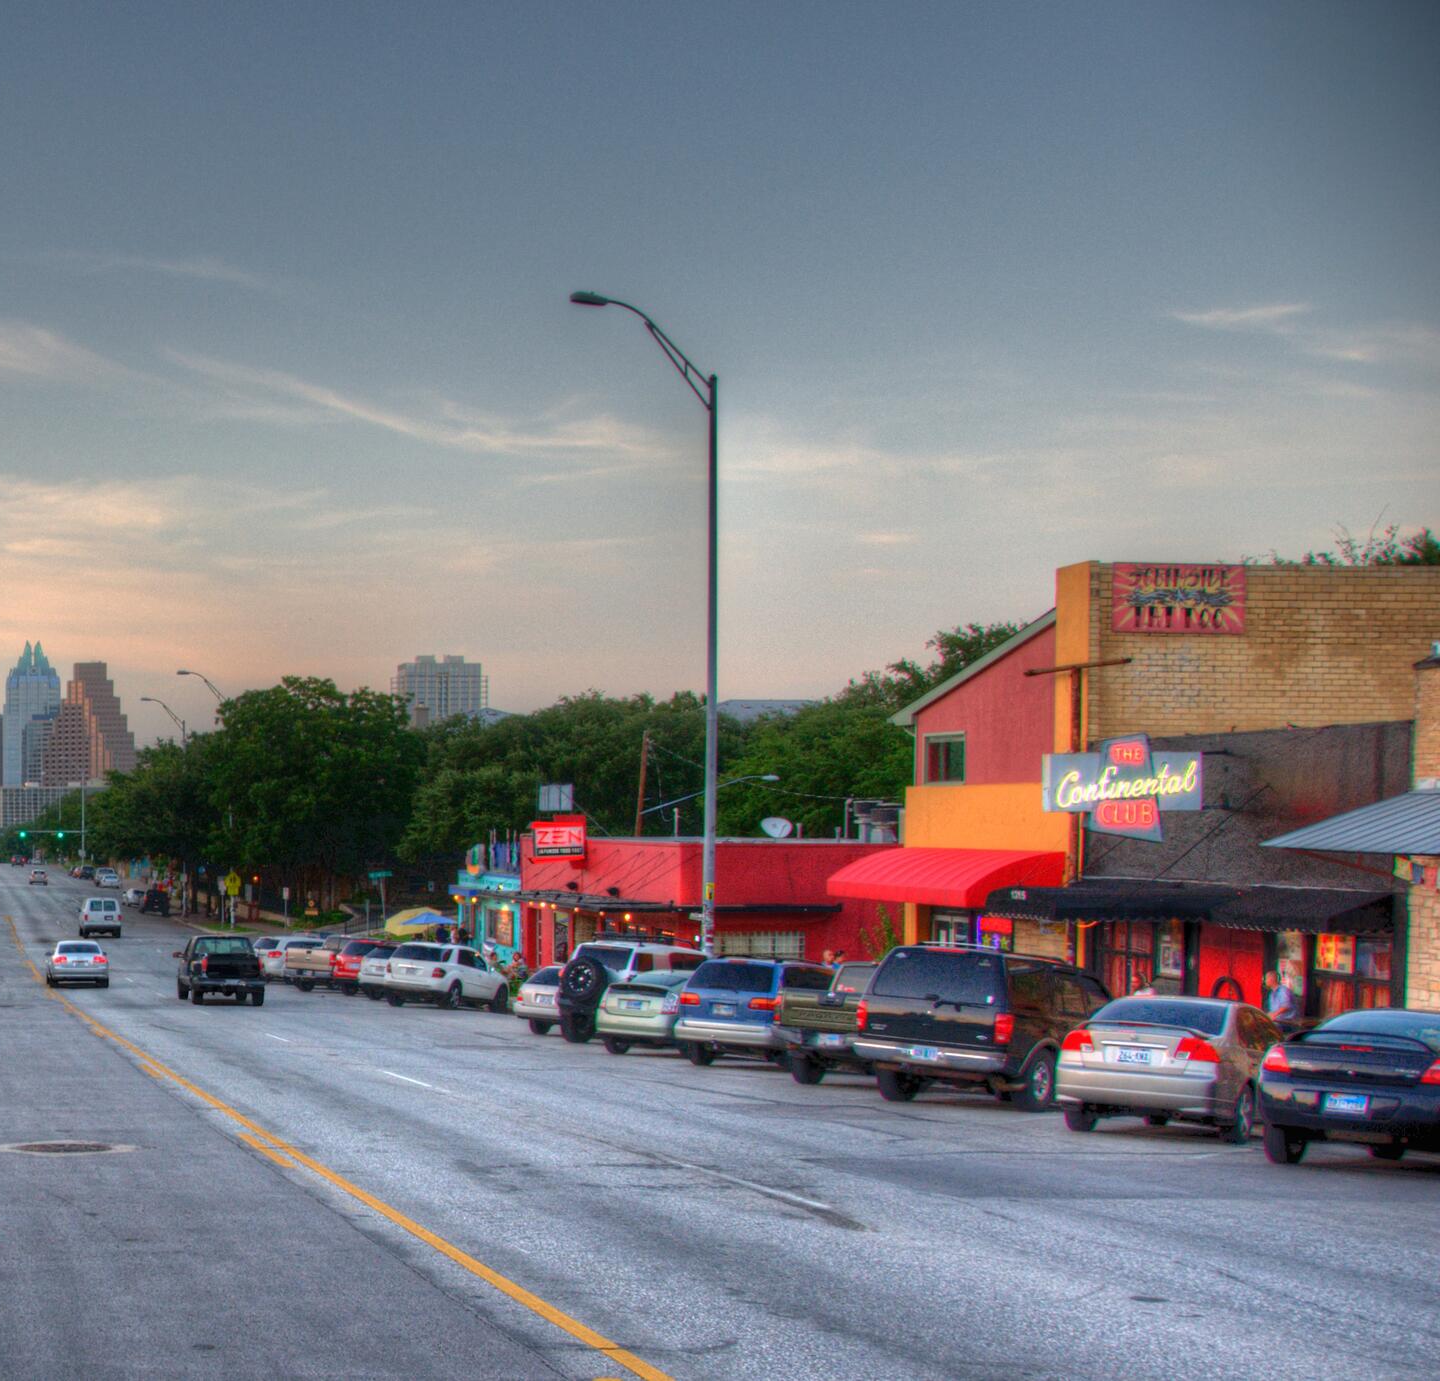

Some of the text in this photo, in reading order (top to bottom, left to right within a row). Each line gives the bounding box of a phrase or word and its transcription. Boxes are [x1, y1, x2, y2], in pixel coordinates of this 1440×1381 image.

[1133, 605, 1225, 629] TATTOO
[1115, 747, 1141, 760] THE
[1055, 759, 1198, 809] Continental
[1100, 800, 1154, 825] CLUB
[536, 829, 582, 846] ZEN
